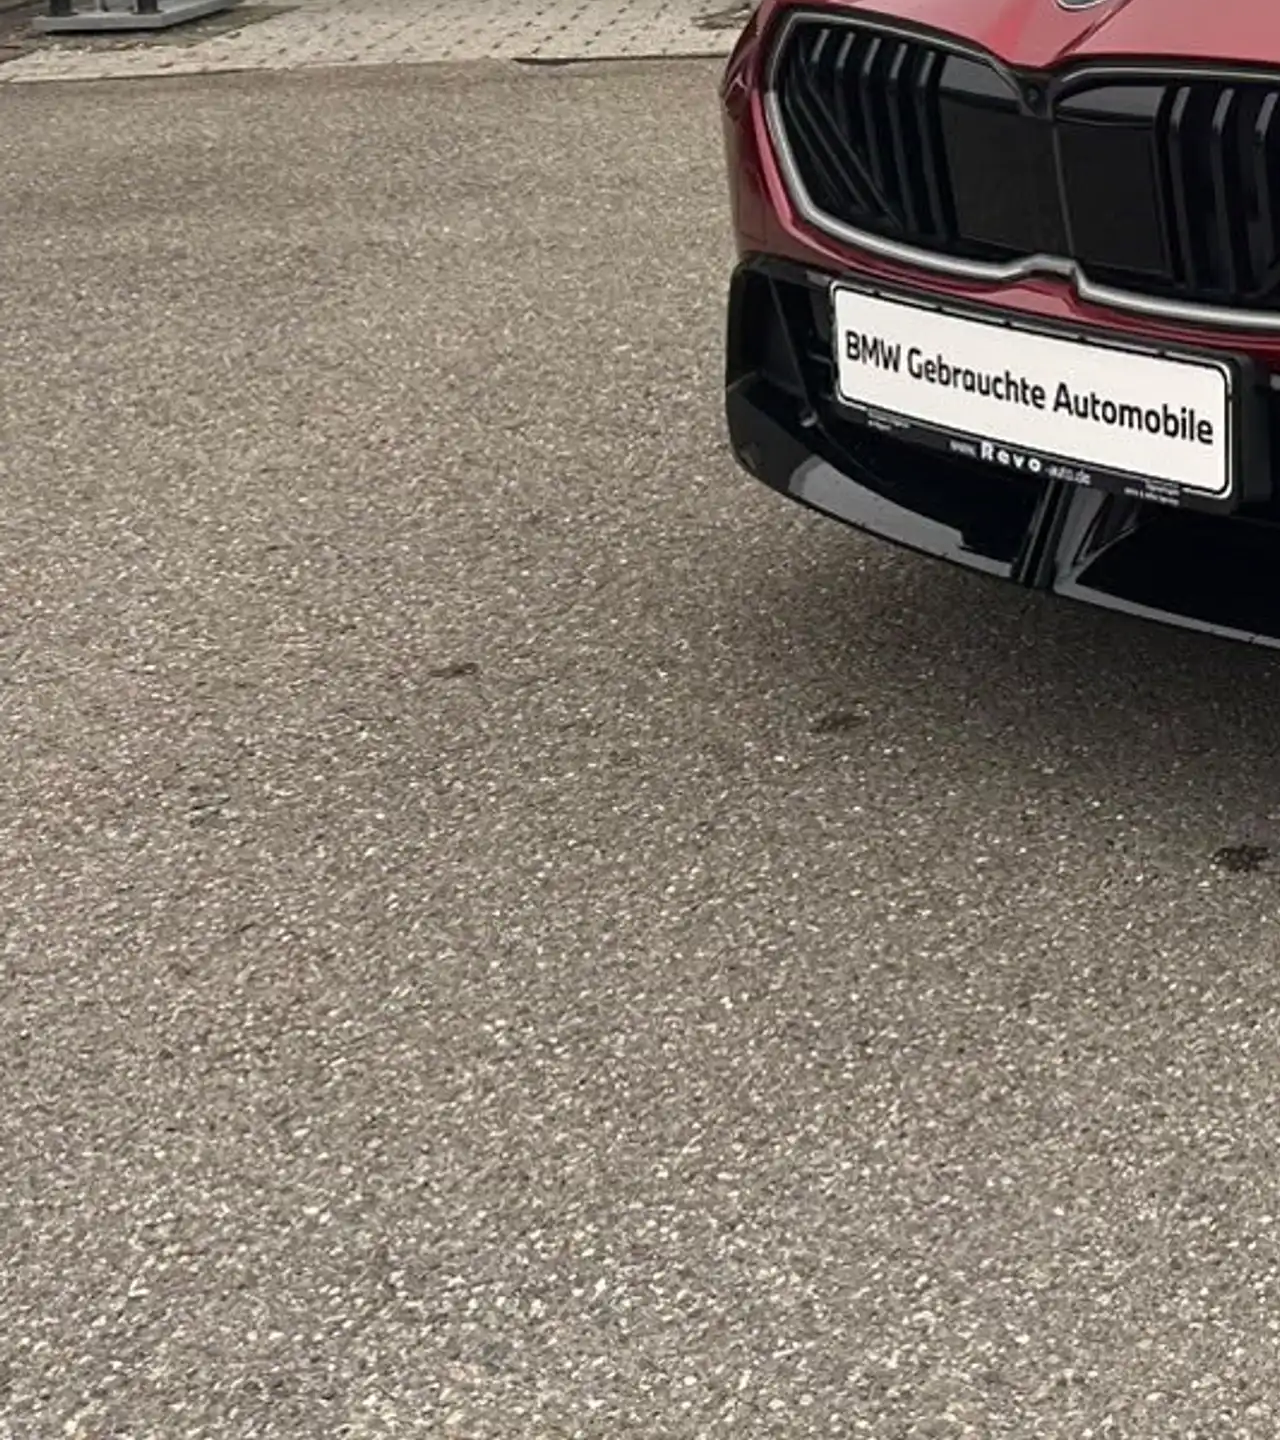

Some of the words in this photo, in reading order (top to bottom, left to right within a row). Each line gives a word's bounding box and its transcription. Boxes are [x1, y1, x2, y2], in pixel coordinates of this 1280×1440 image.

[846, 330, 901, 373] BMW
[907, 348, 1046, 408] Gebrauchte
[1053, 383, 1214, 445] Automobile
